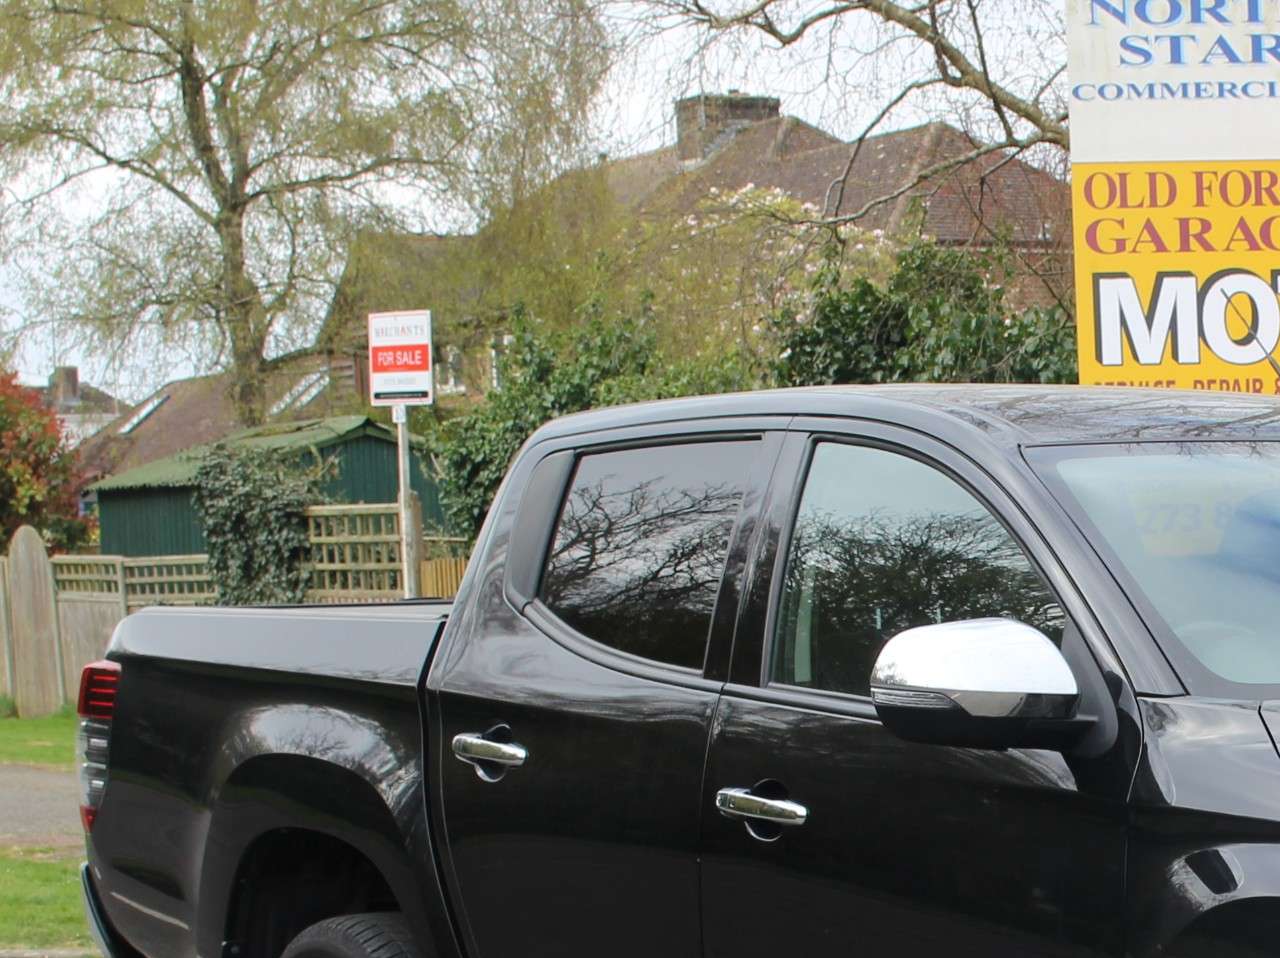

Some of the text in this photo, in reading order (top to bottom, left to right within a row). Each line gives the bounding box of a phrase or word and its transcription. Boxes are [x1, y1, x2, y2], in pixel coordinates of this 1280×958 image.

[1083, 170, 1178, 209] OLD
[378, 350, 422, 366] FOR SALE
